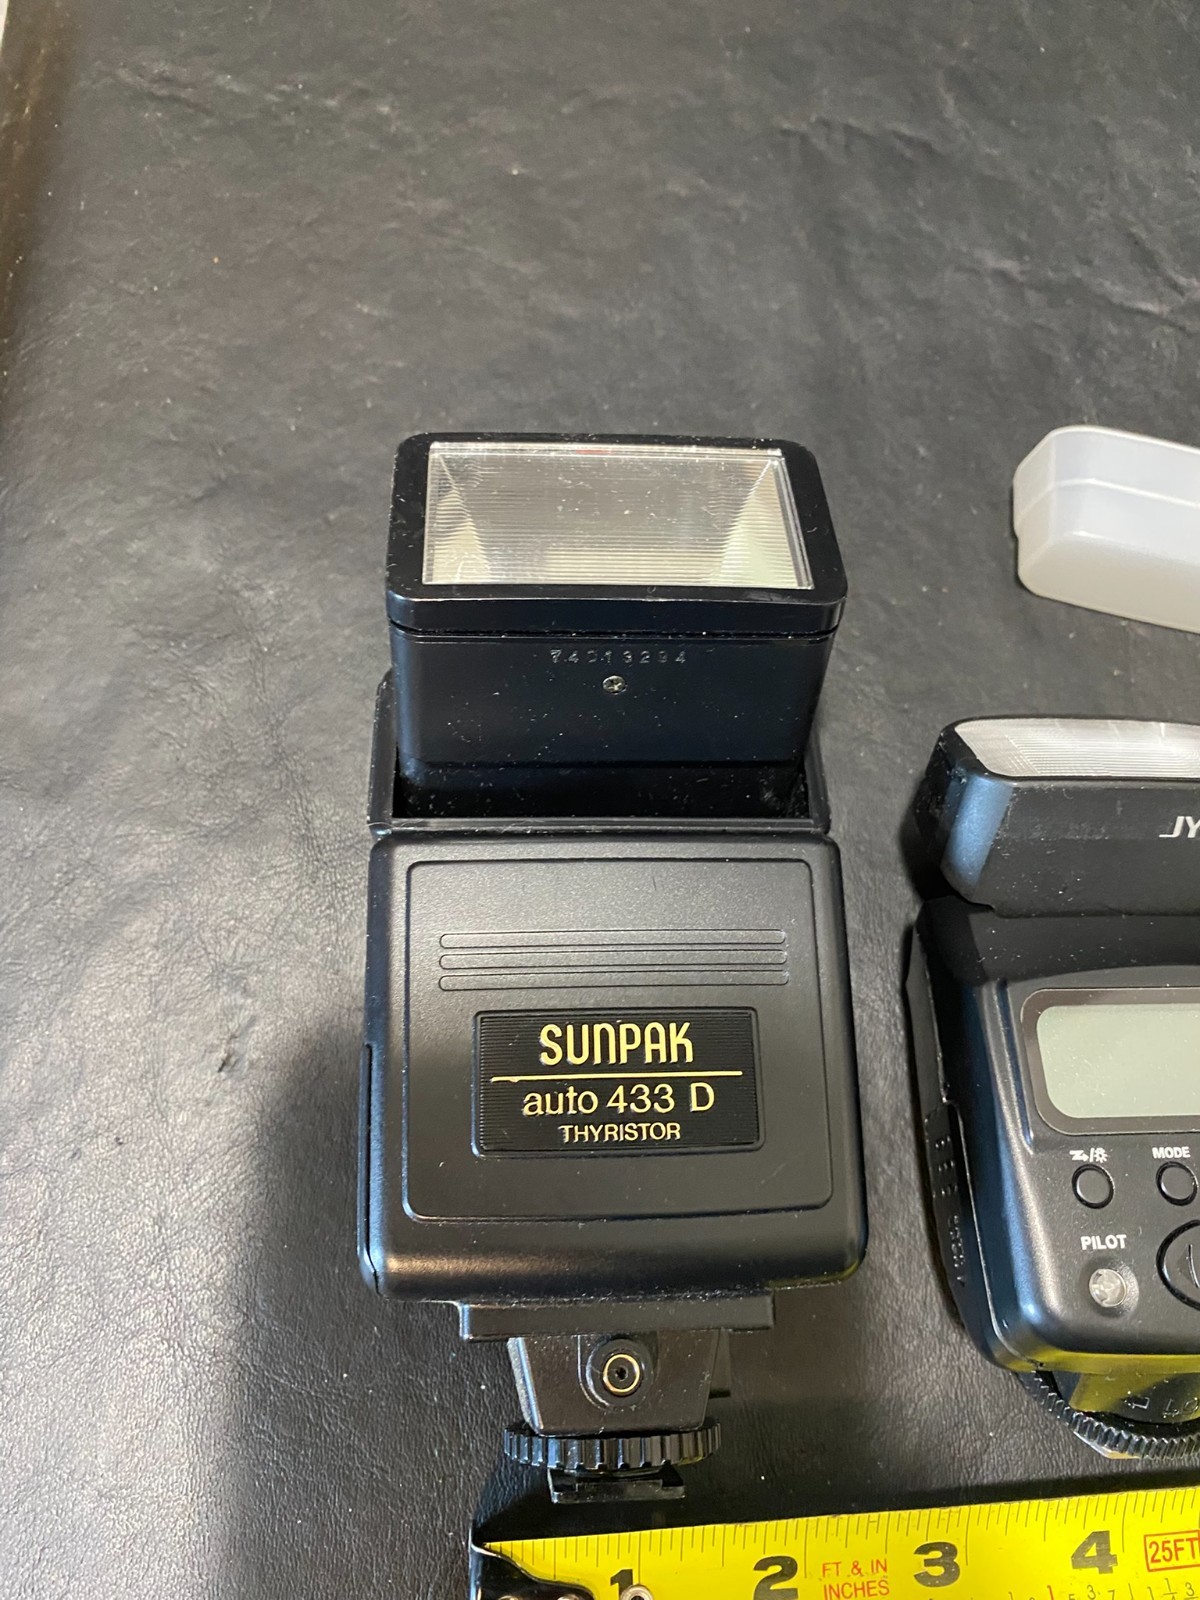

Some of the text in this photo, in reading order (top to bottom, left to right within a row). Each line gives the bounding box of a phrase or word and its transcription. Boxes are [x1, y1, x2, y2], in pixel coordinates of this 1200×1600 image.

[539, 1022, 694, 1066] SUNPAK
[522, 1082, 715, 1116] auto 433 D
[559, 1122, 681, 1143] THYRISTOR
[1152, 1146, 1191, 1159] MODE
[1081, 1234, 1127, 1250] PILOT
[1071, 1530, 1118, 1575] 4
[1149, 1537, 1200, 1563] 25FT
[753, 1555, 799, 1600] 2
[822, 1558, 888, 1577] FT & IN
[913, 1541, 961, 1588] 3
[823, 1579, 890, 1600] INCHES
